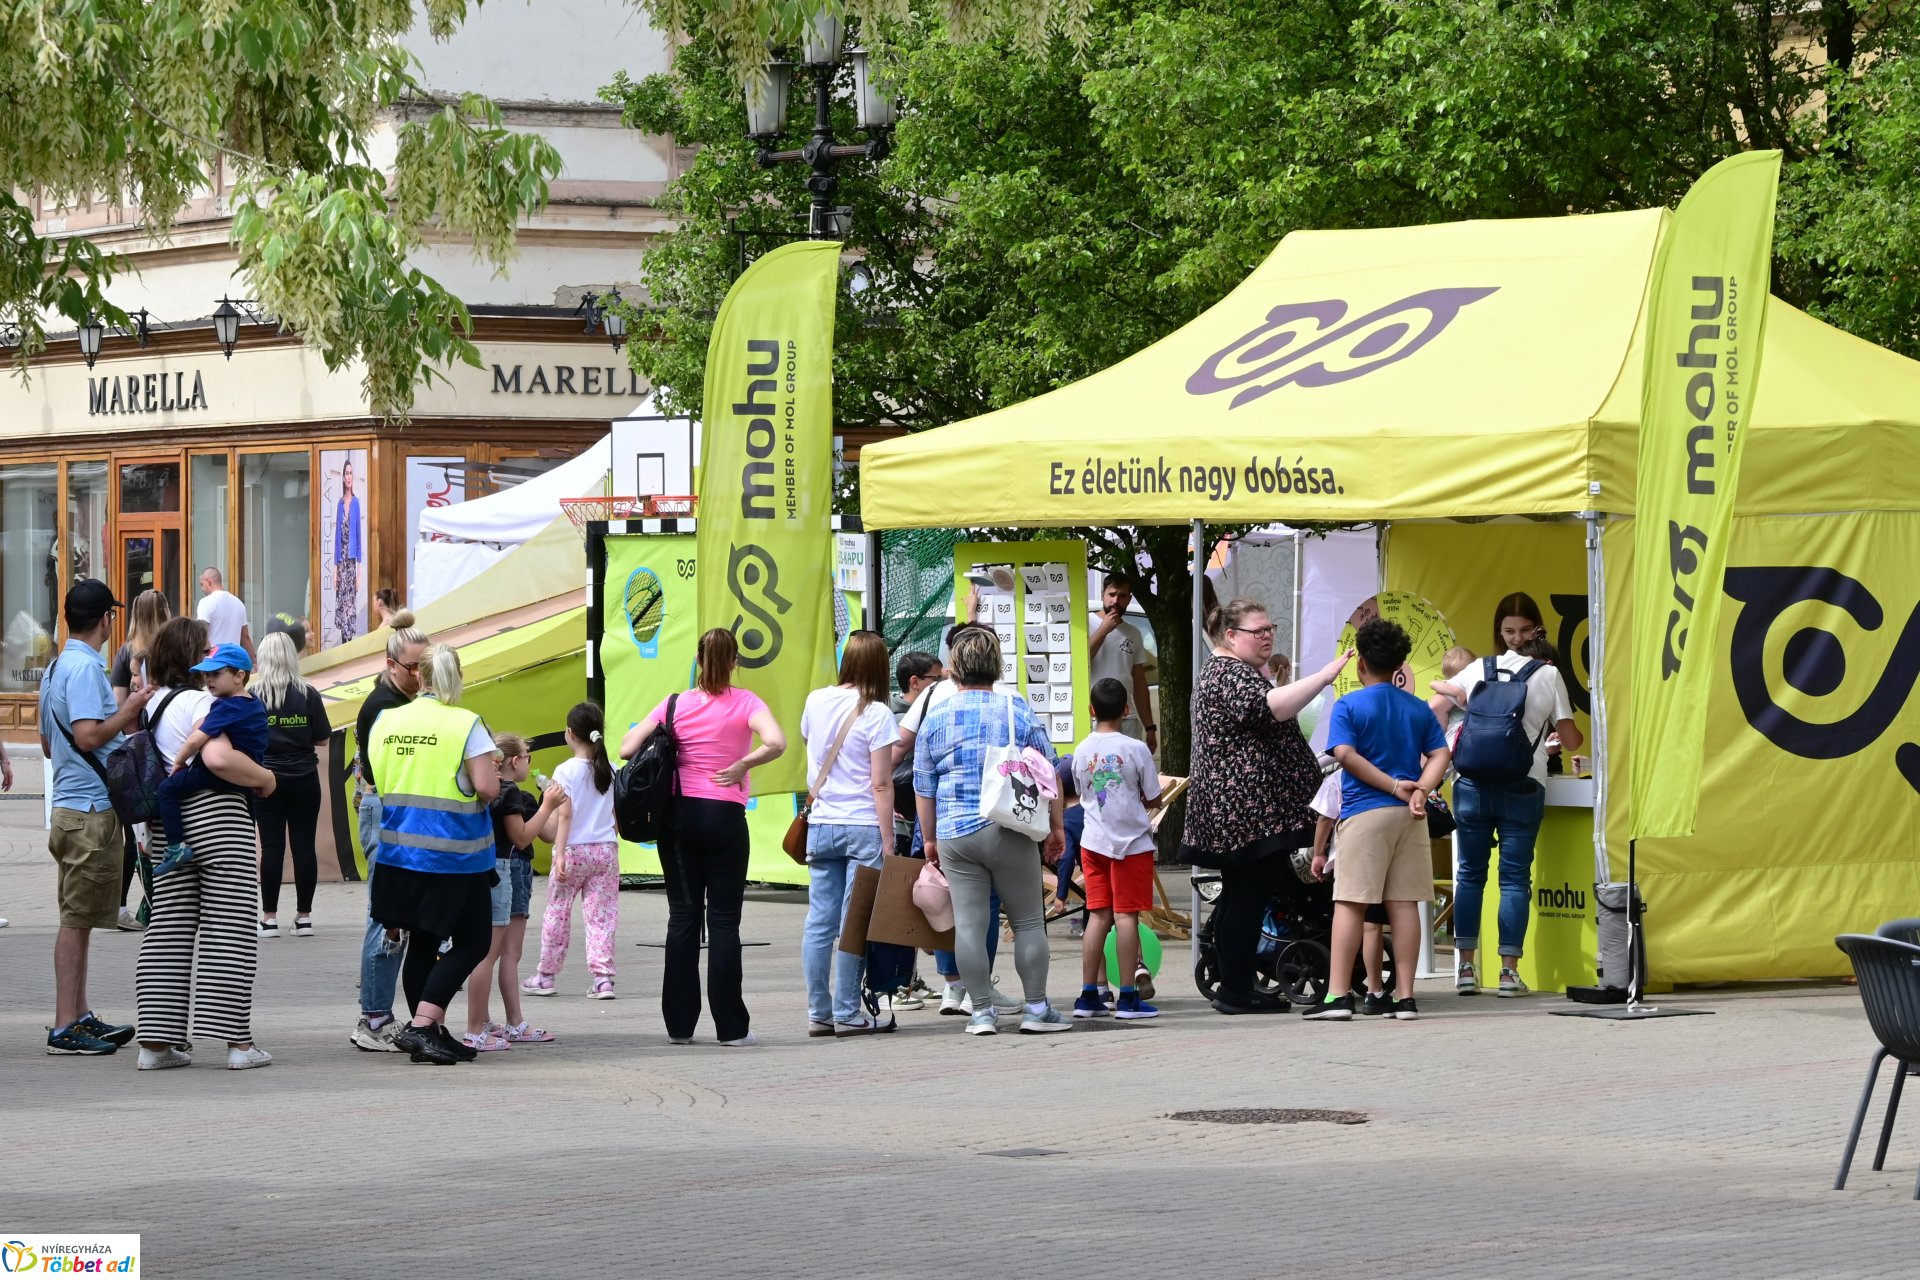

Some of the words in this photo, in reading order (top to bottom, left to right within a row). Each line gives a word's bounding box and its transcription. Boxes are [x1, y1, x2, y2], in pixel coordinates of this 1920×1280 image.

[1726, 276, 1738, 341] GROUP
[491, 364, 650, 396] MARELL
[786, 340, 797, 393] GROUP
[1676, 276, 1724, 495] mohu
[1726, 347, 1739, 385] MOL
[88, 369, 209, 416] MARELLA
[785, 398, 795, 430] MOL
[1726, 391, 1739, 414] OF
[732, 339, 780, 520] mohu
[785, 433, 795, 454] OF
[785, 457, 797, 520] MEMBER
[1050, 462, 1075, 495] Ez
[1081, 456, 1172, 495] életünk
[1179, 464, 1236, 501] nagy
[1244, 456, 1345, 495] dobása.
[323, 471, 333, 591] BARCLAY
[323, 603, 332, 648] TTY
[280, 714, 307, 725] mohu
[383, 733, 438, 746] RENDEZŐ
[1538, 882, 1585, 909] mohu
